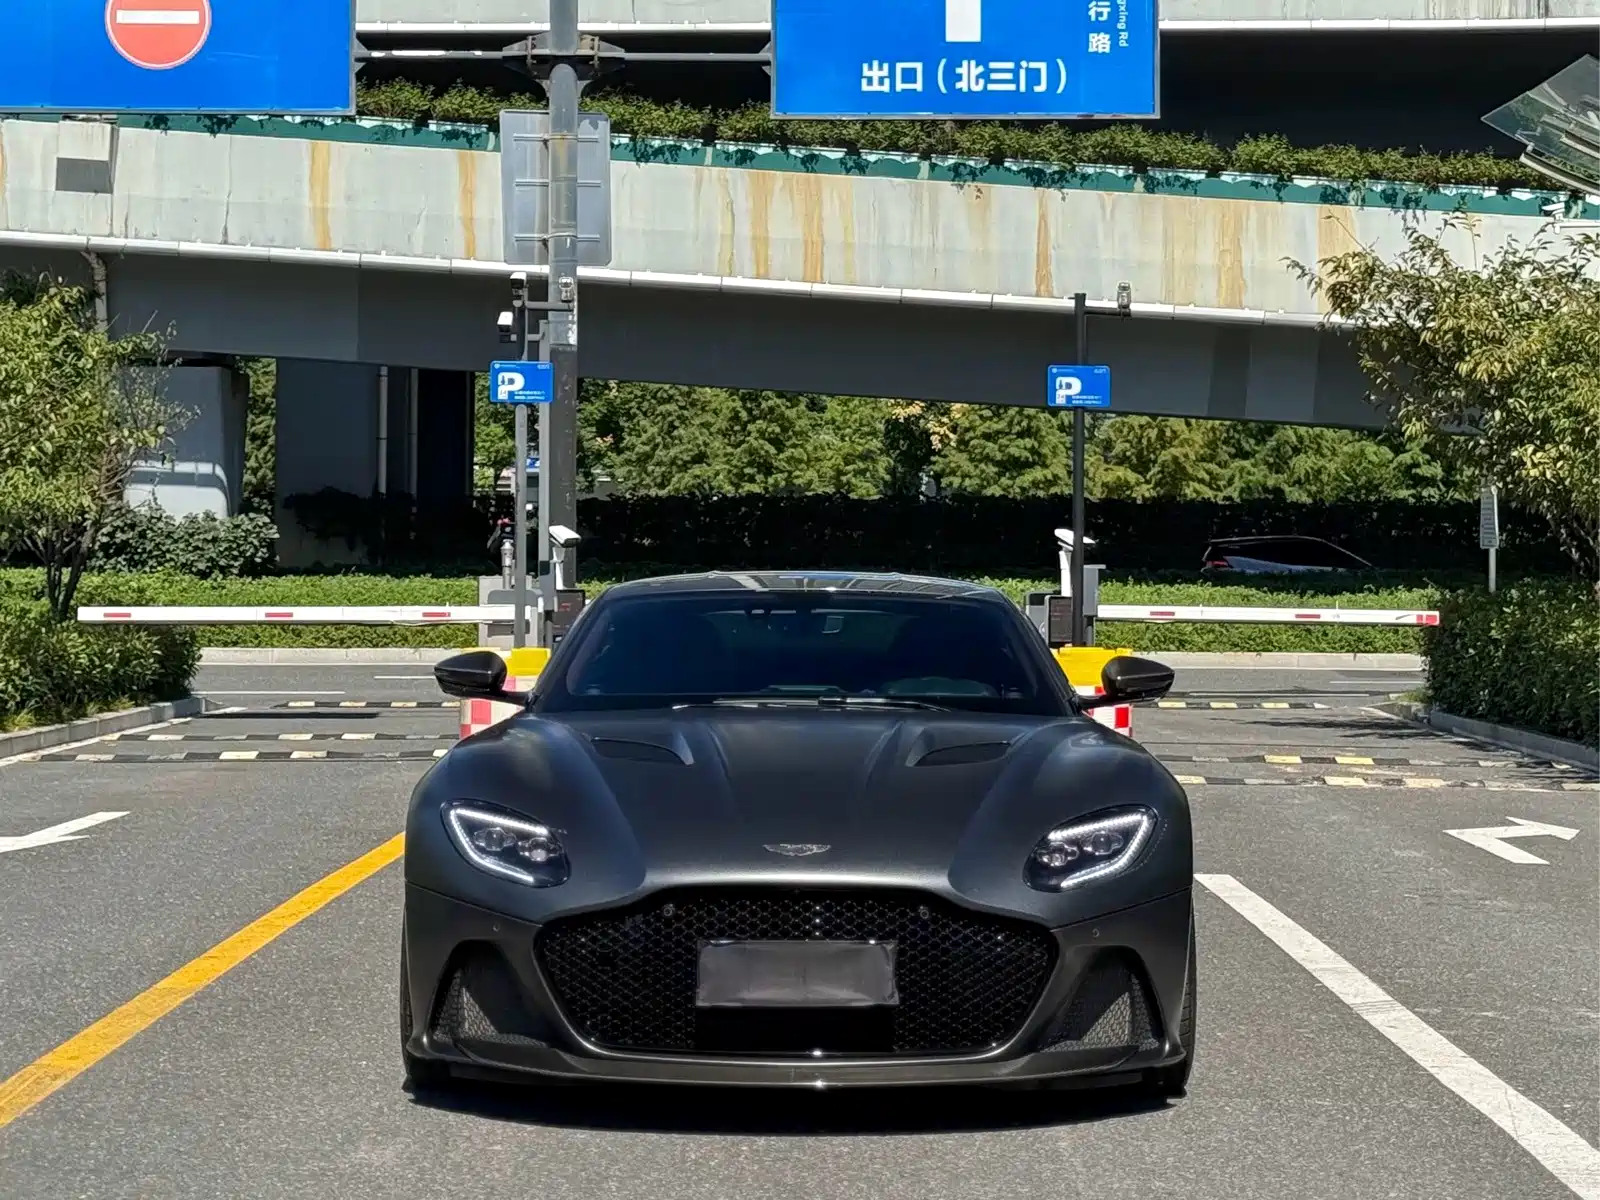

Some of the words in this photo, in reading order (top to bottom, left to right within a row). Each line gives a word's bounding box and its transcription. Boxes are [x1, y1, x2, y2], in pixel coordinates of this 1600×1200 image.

[1118, 31, 1129, 47] Rd
[498, 372, 525, 399] P
[1056, 377, 1082, 404] P
